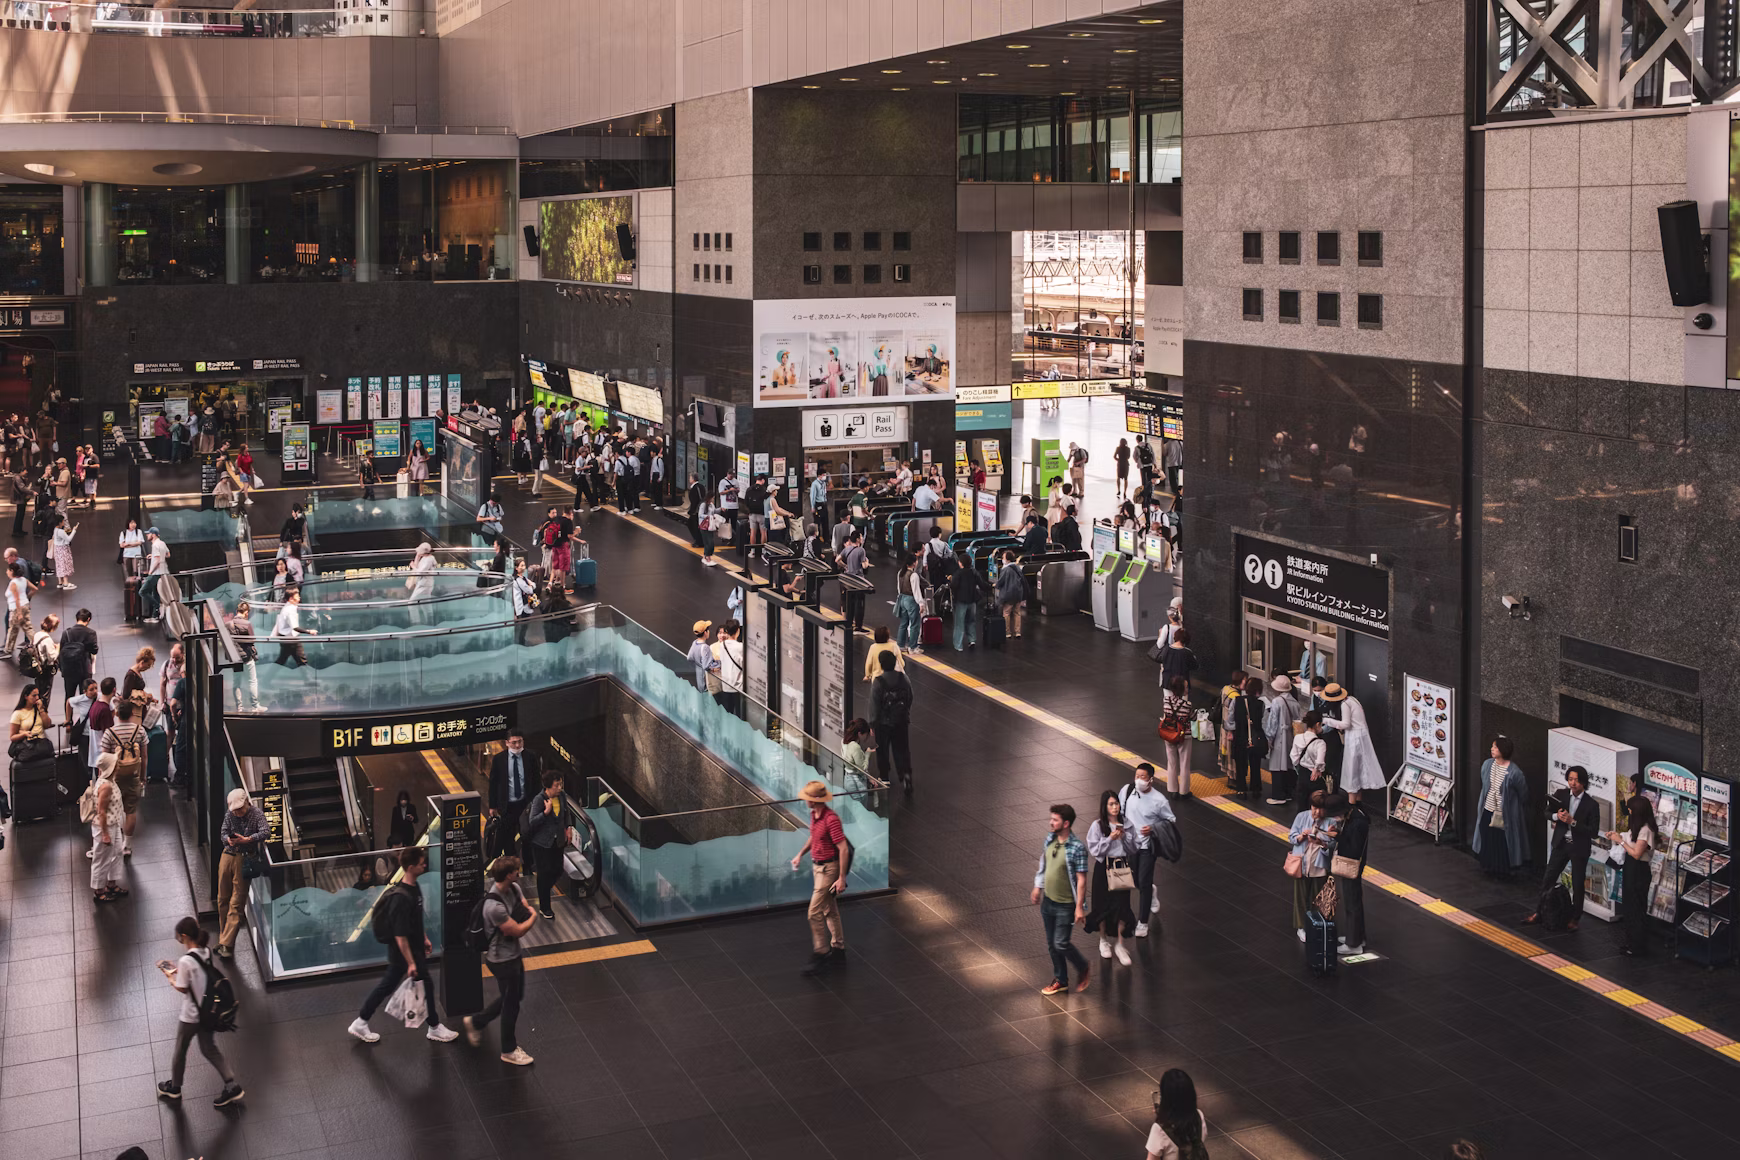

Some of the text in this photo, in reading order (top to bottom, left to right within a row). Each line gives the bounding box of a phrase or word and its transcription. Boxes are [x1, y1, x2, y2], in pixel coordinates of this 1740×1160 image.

[876, 415, 891, 424] Rail
[875, 425, 892, 433] Pass
[1286, 555, 1329, 577] 鉄道案内所
[1293, 570, 1324, 584] Information
[1286, 583, 1387, 619] 駅ビルインフォメーション
[1286, 595, 1389, 631] KYOTO STATION BUILDING Information
[333, 713, 507, 748] B1F お手洗 コインロッカー
[436, 723, 507, 739] LAVATORY COIN LOCKERS
[1649, 769, 1697, 796] おでかけ情報
[1710, 786, 1728, 797] Navi
[453, 818, 471, 829] B1F
